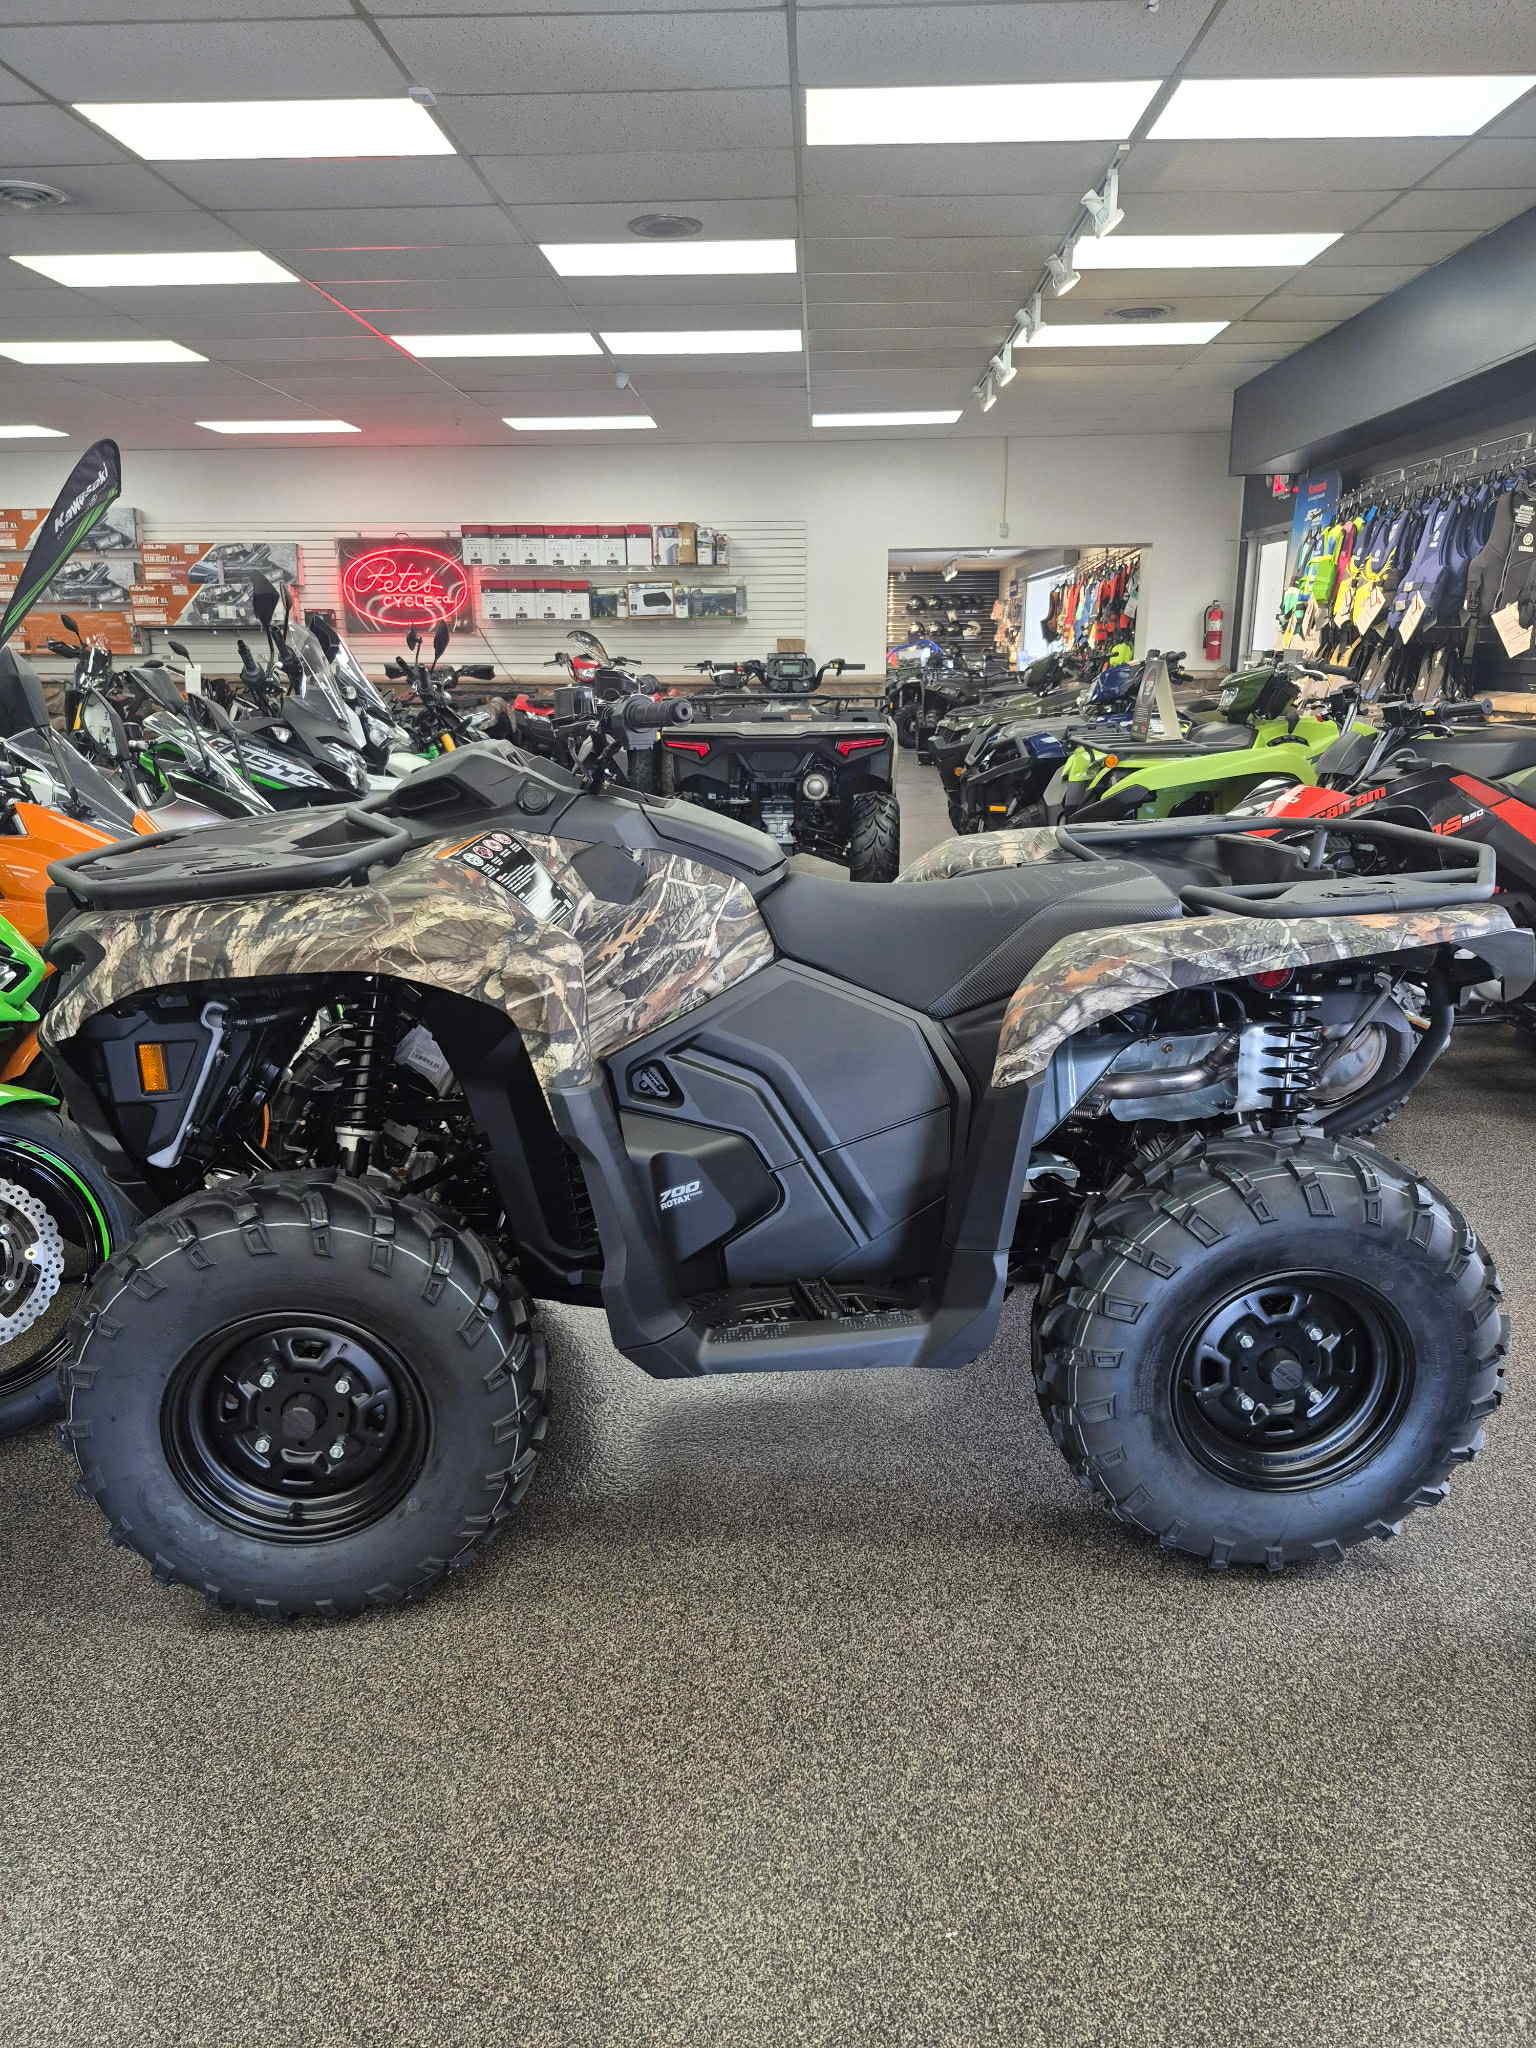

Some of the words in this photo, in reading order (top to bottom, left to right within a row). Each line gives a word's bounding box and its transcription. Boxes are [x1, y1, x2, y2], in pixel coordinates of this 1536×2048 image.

[54, 461, 109, 533] Kawasaki
[353, 557, 444, 593] Pete's
[383, 595, 433, 607] CYCLE
[659, 1180, 700, 1203] 700
[660, 1194, 691, 1211] ROTAX
